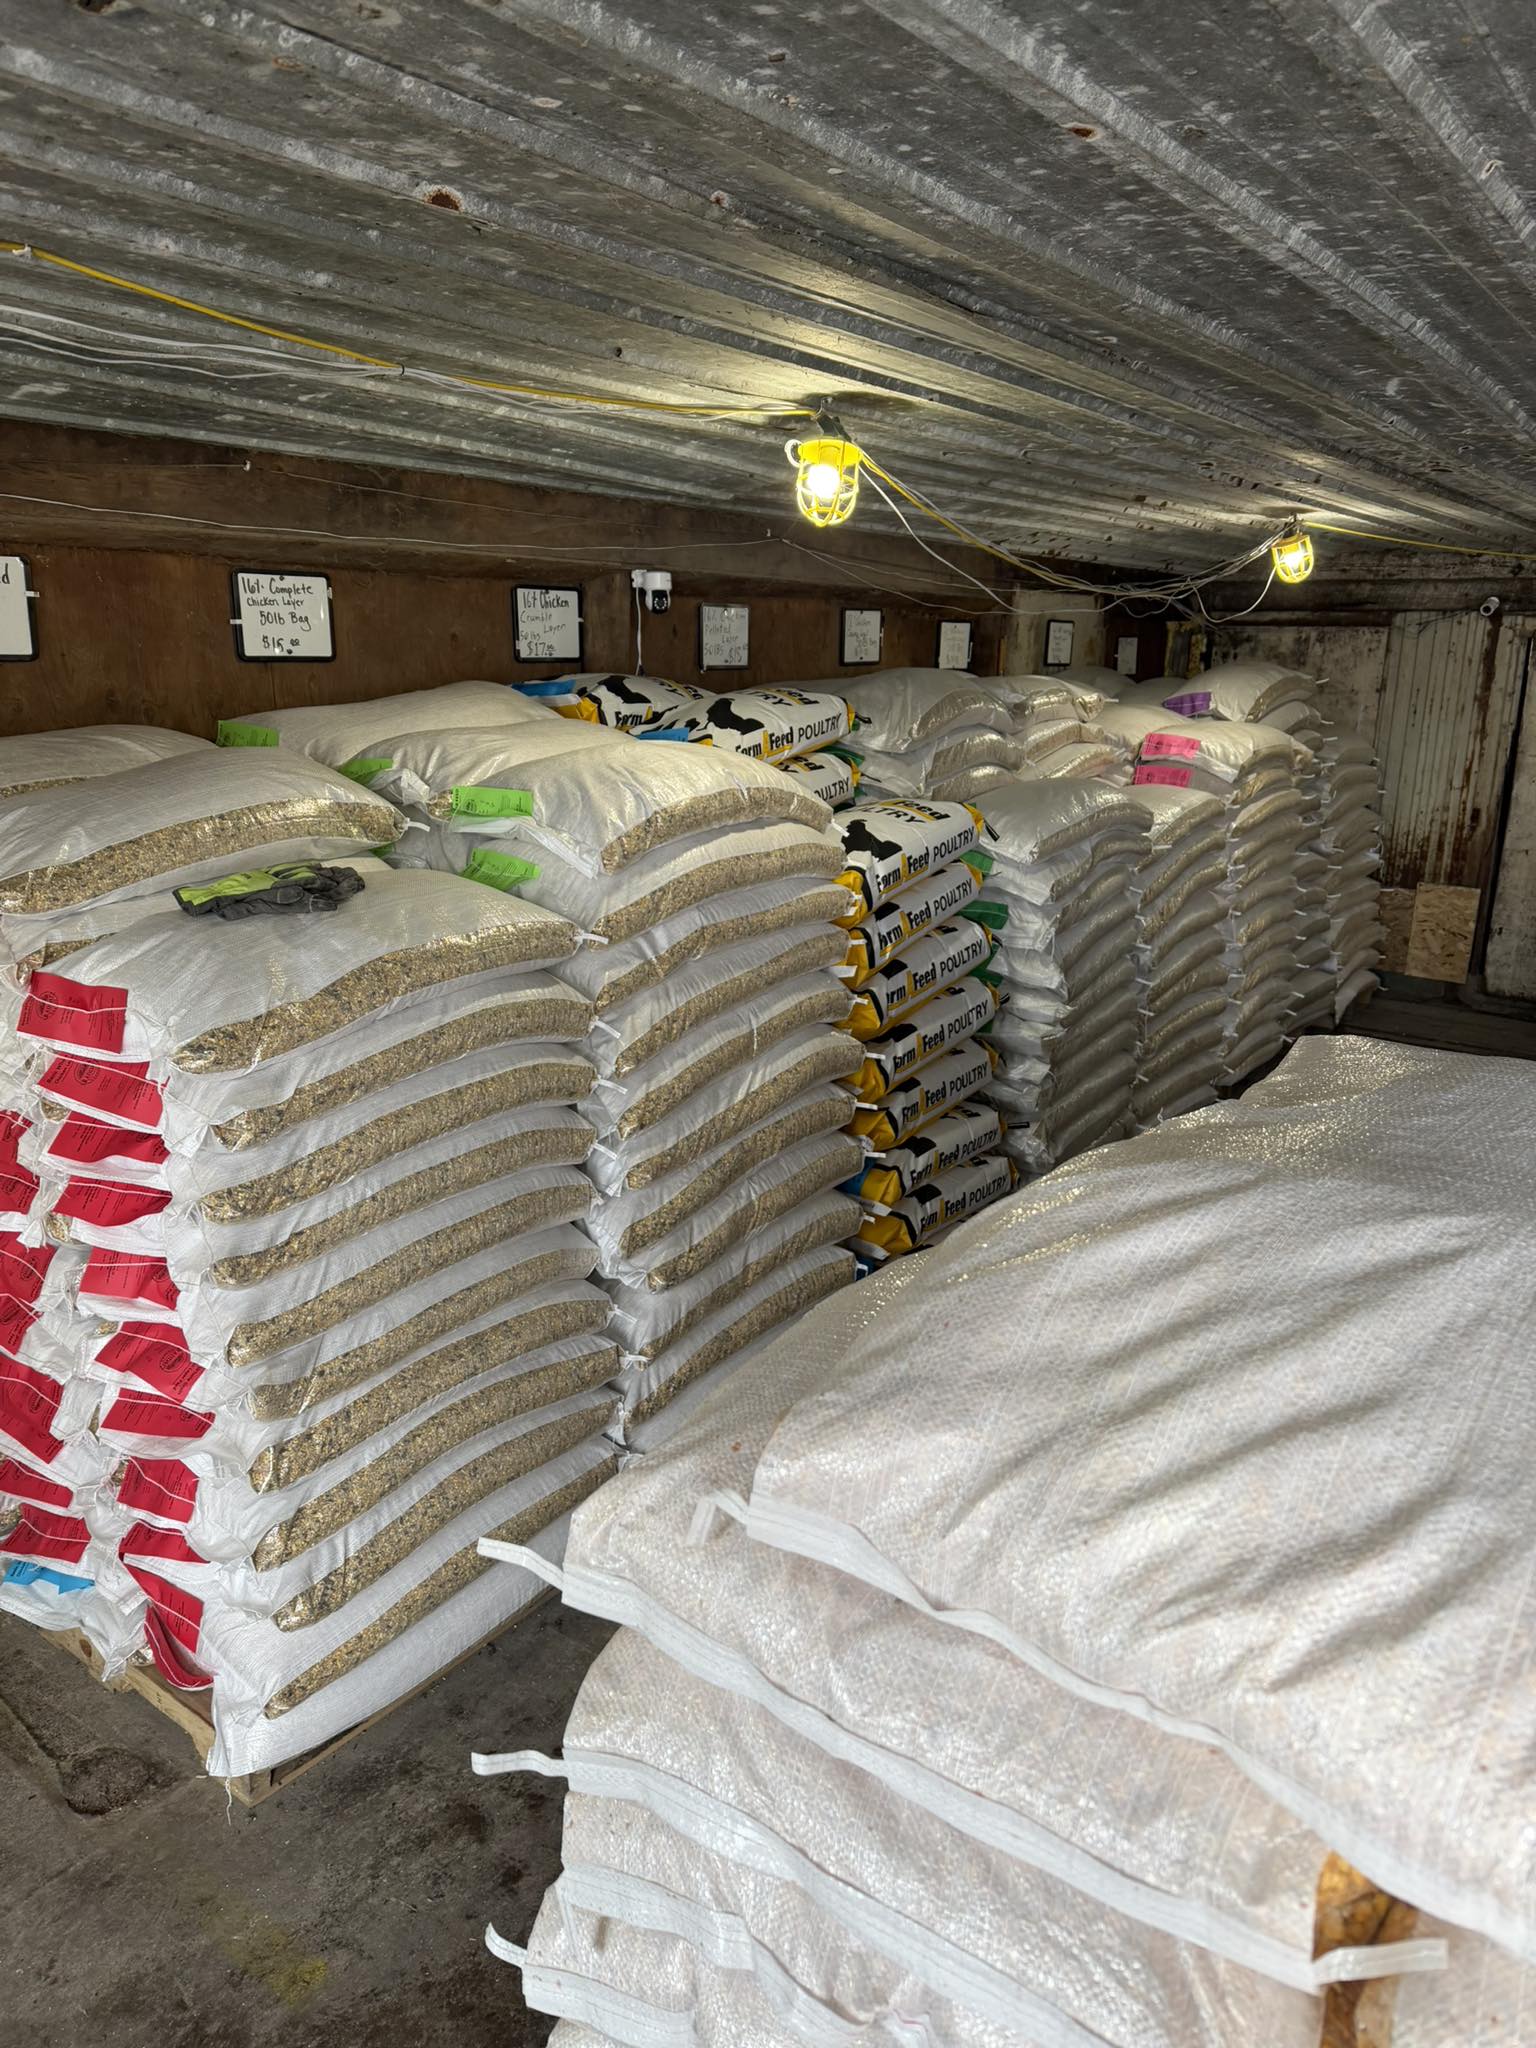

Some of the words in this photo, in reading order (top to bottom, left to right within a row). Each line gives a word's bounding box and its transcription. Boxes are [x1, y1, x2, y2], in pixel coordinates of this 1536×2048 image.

[246, 597, 279, 607] Chicken
[282, 596, 304, 610] Layer
[269, 577, 314, 598] Complete
[539, 590, 570, 608] Chicken
[259, 610, 285, 625] 50lb
[288, 611, 312, 632] Bag
[520, 610, 553, 624] Crumble
[768, 726, 794, 751] Feed
[798, 713, 842, 743] POULTRY
[907, 846, 931, 874] Feed
[933, 826, 975, 862] POULTRY
[906, 900, 932, 931] Feed
[933, 878, 974, 917] POULTRY
[911, 962, 938, 992] Feed
[940, 938, 983, 978] POULTRY
[921, 1024, 946, 1053] Feed
[947, 999, 989, 1039] POULTRY
[924, 1081, 948, 1108] Feed
[949, 1060, 989, 1097] POULTRY
[939, 1143, 961, 1169] Feed
[944, 1191, 967, 1218] Feed
[968, 1175, 1009, 1208] POULTRY
